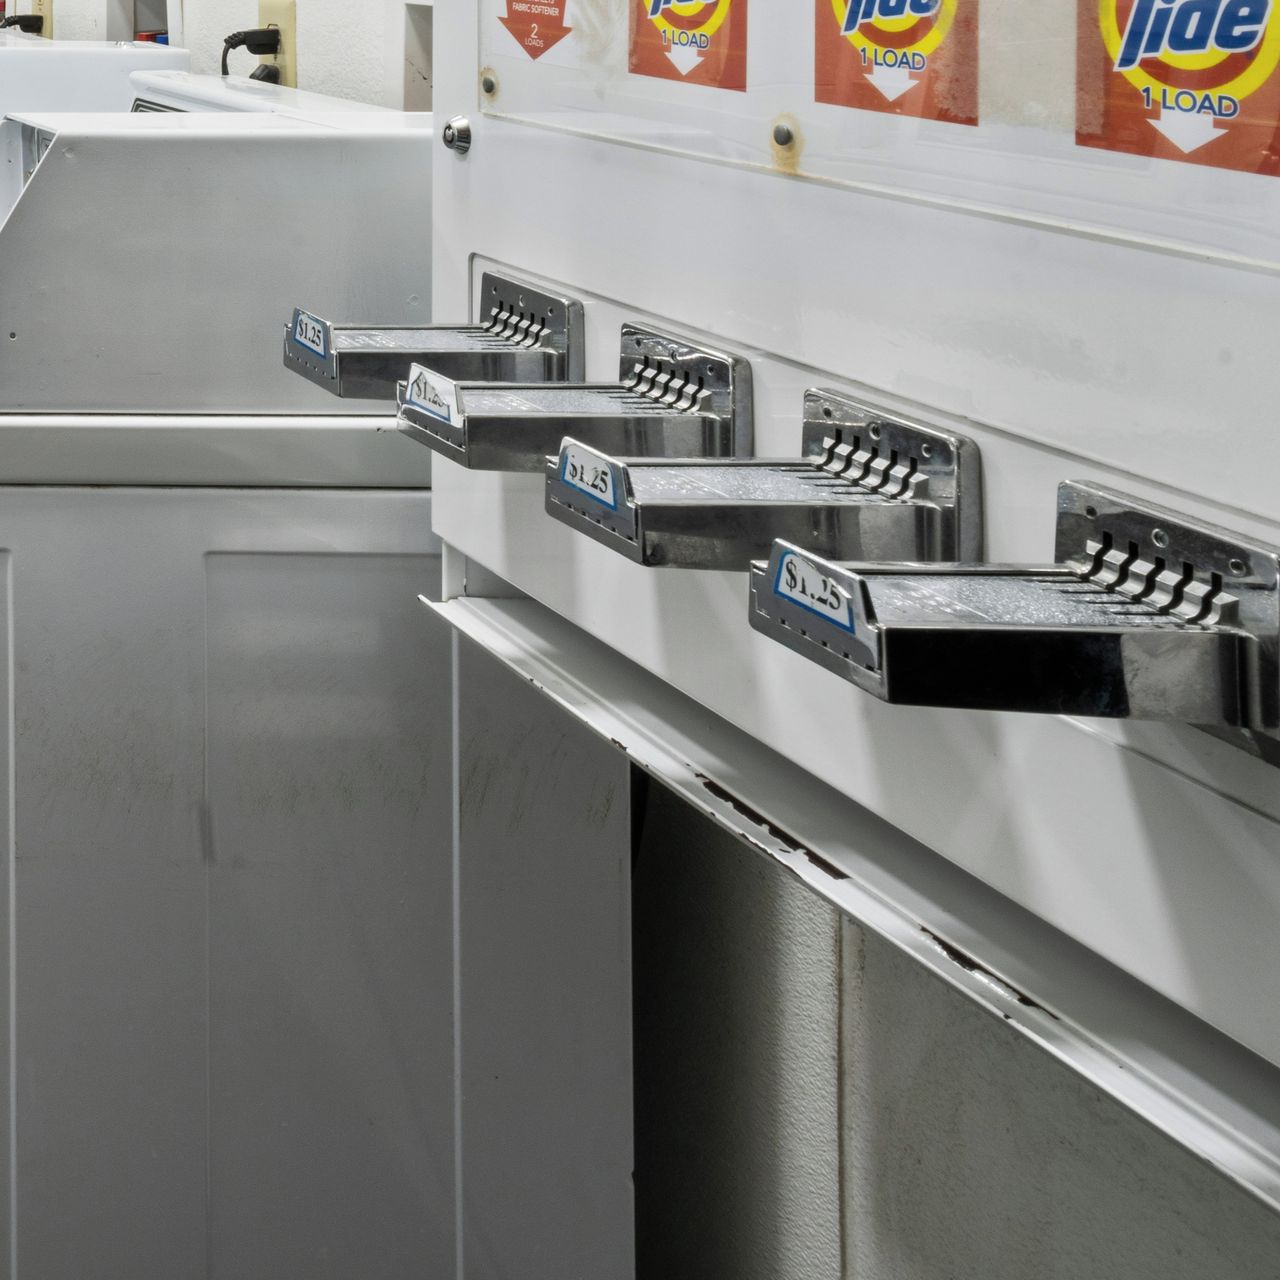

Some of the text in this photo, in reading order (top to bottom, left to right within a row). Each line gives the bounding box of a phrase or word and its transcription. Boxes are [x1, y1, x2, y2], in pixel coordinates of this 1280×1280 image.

[512, 2, 560, 16] FABRIC SOFTENER
[524, 37, 544, 48] LOADS
[530, 23, 538, 39] 2
[661, 29, 710, 49] 1 LOAD
[859, 47, 927, 71] 1 LOAD
[1141, 86, 1239, 119] 1 LOAD
[298, 317, 322, 347] $1.25
[569, 455, 609, 495] $1.25
[785, 558, 842, 611] $1.25
